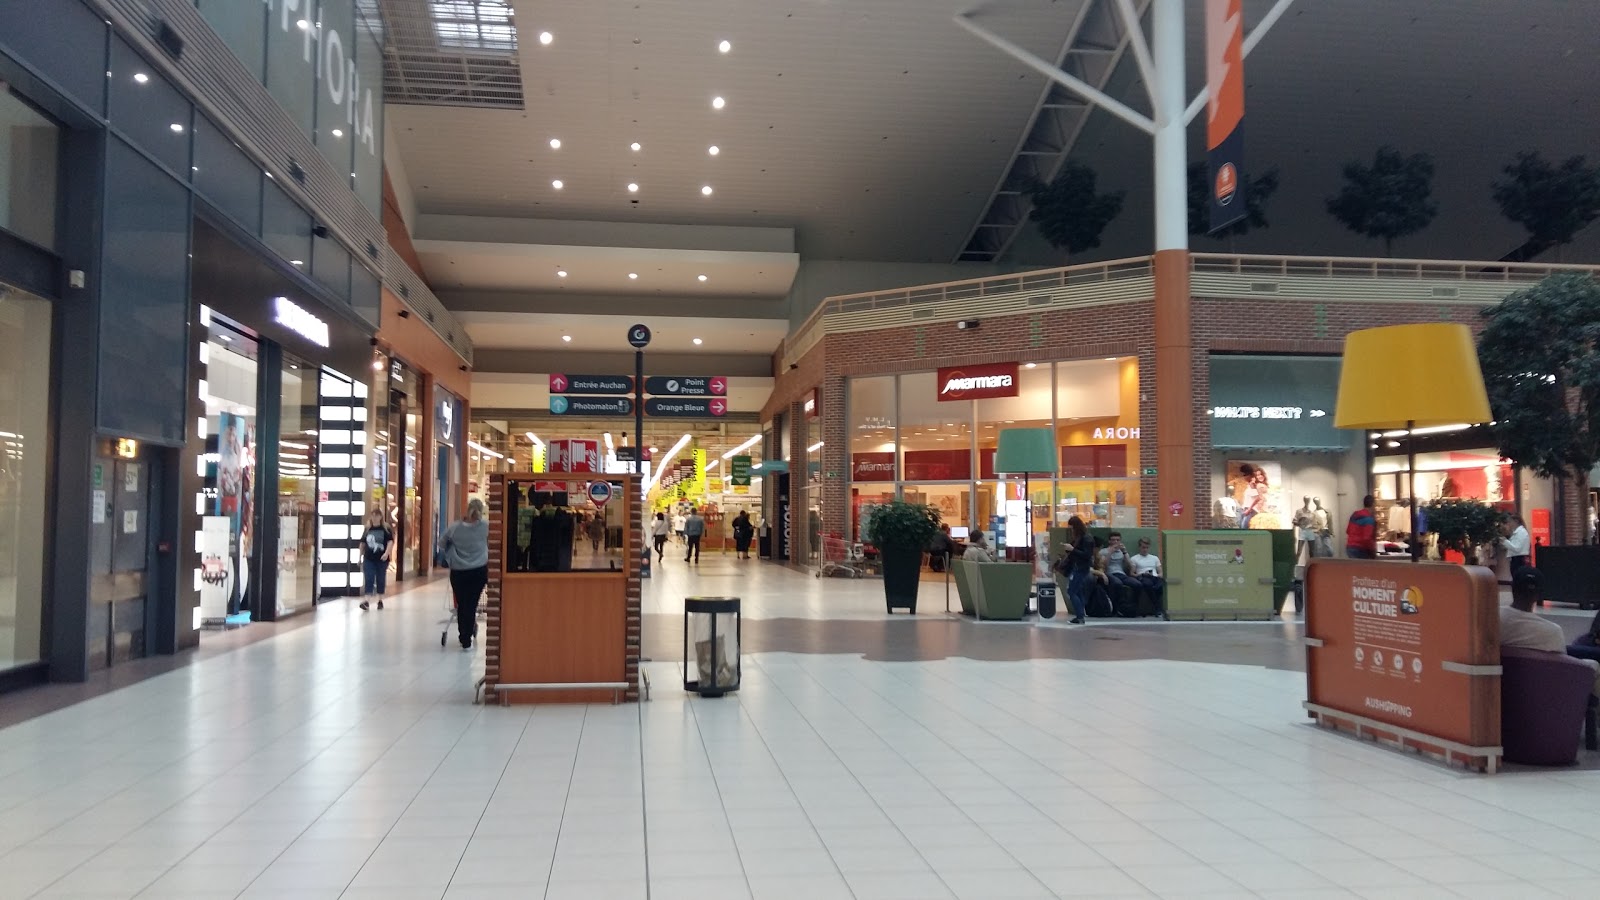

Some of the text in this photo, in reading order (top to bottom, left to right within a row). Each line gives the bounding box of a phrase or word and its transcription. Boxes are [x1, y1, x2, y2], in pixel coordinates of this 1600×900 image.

[574, 381, 627, 390] Entrée Auchan
[685, 378, 705, 387] Point
[681, 387, 705, 395] Presse
[573, 402, 618, 411] Photomaton
[657, 403, 705, 412] Orange Bleue
[1261, 406, 1303, 419] NEXT?
[1352, 575, 1397, 588] Profitez d'un
[1353, 586, 1397, 603] MOMENT
[1353, 600, 1398, 617] CULTURE
